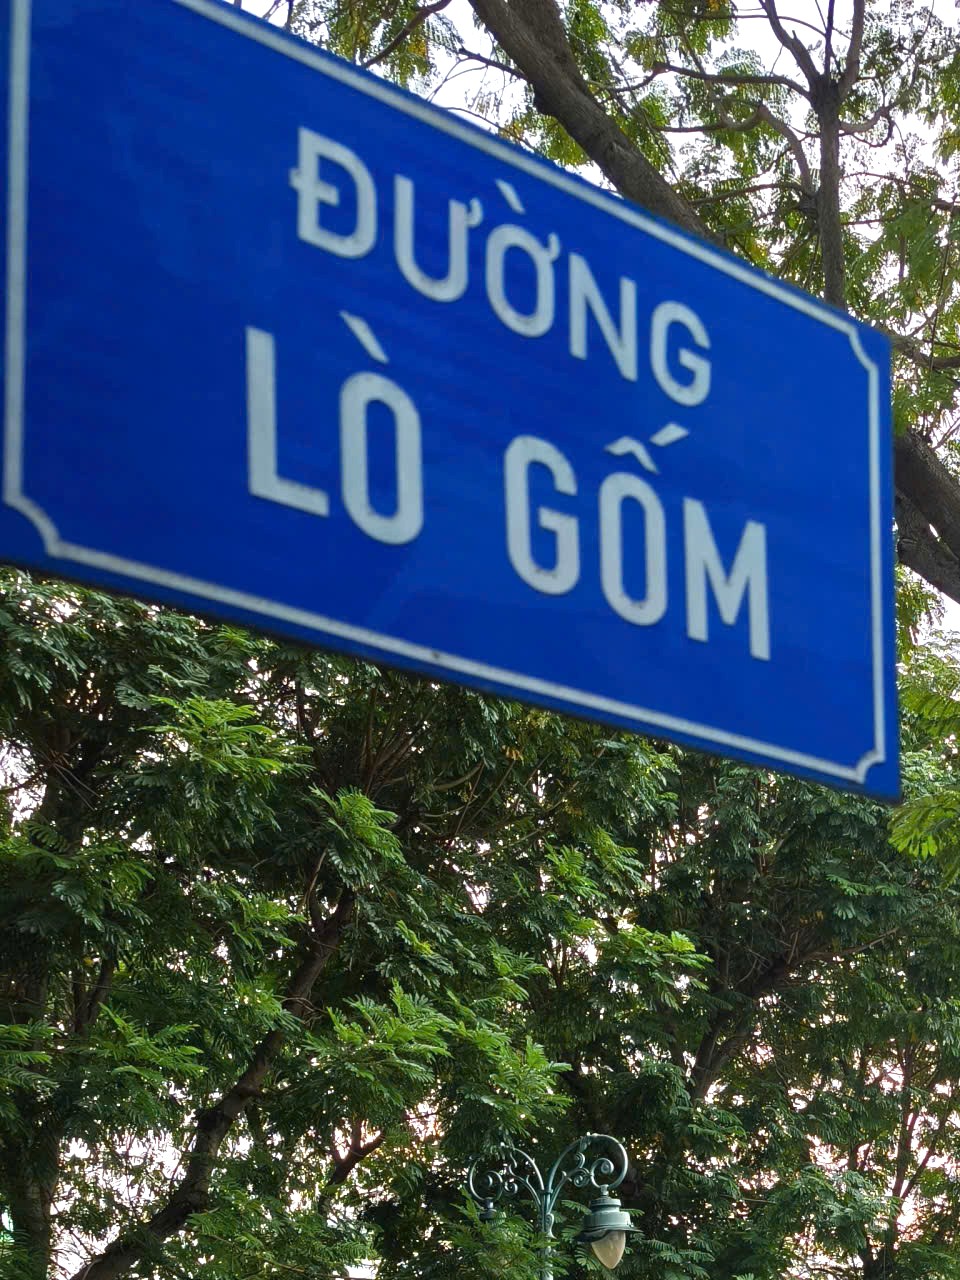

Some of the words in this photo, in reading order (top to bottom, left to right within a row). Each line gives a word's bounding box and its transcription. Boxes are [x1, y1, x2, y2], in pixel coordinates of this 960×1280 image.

[290, 127, 712, 406] ĐƯỜNG
[245, 310, 424, 545] LÒ
[503, 422, 771, 661] GỐM
